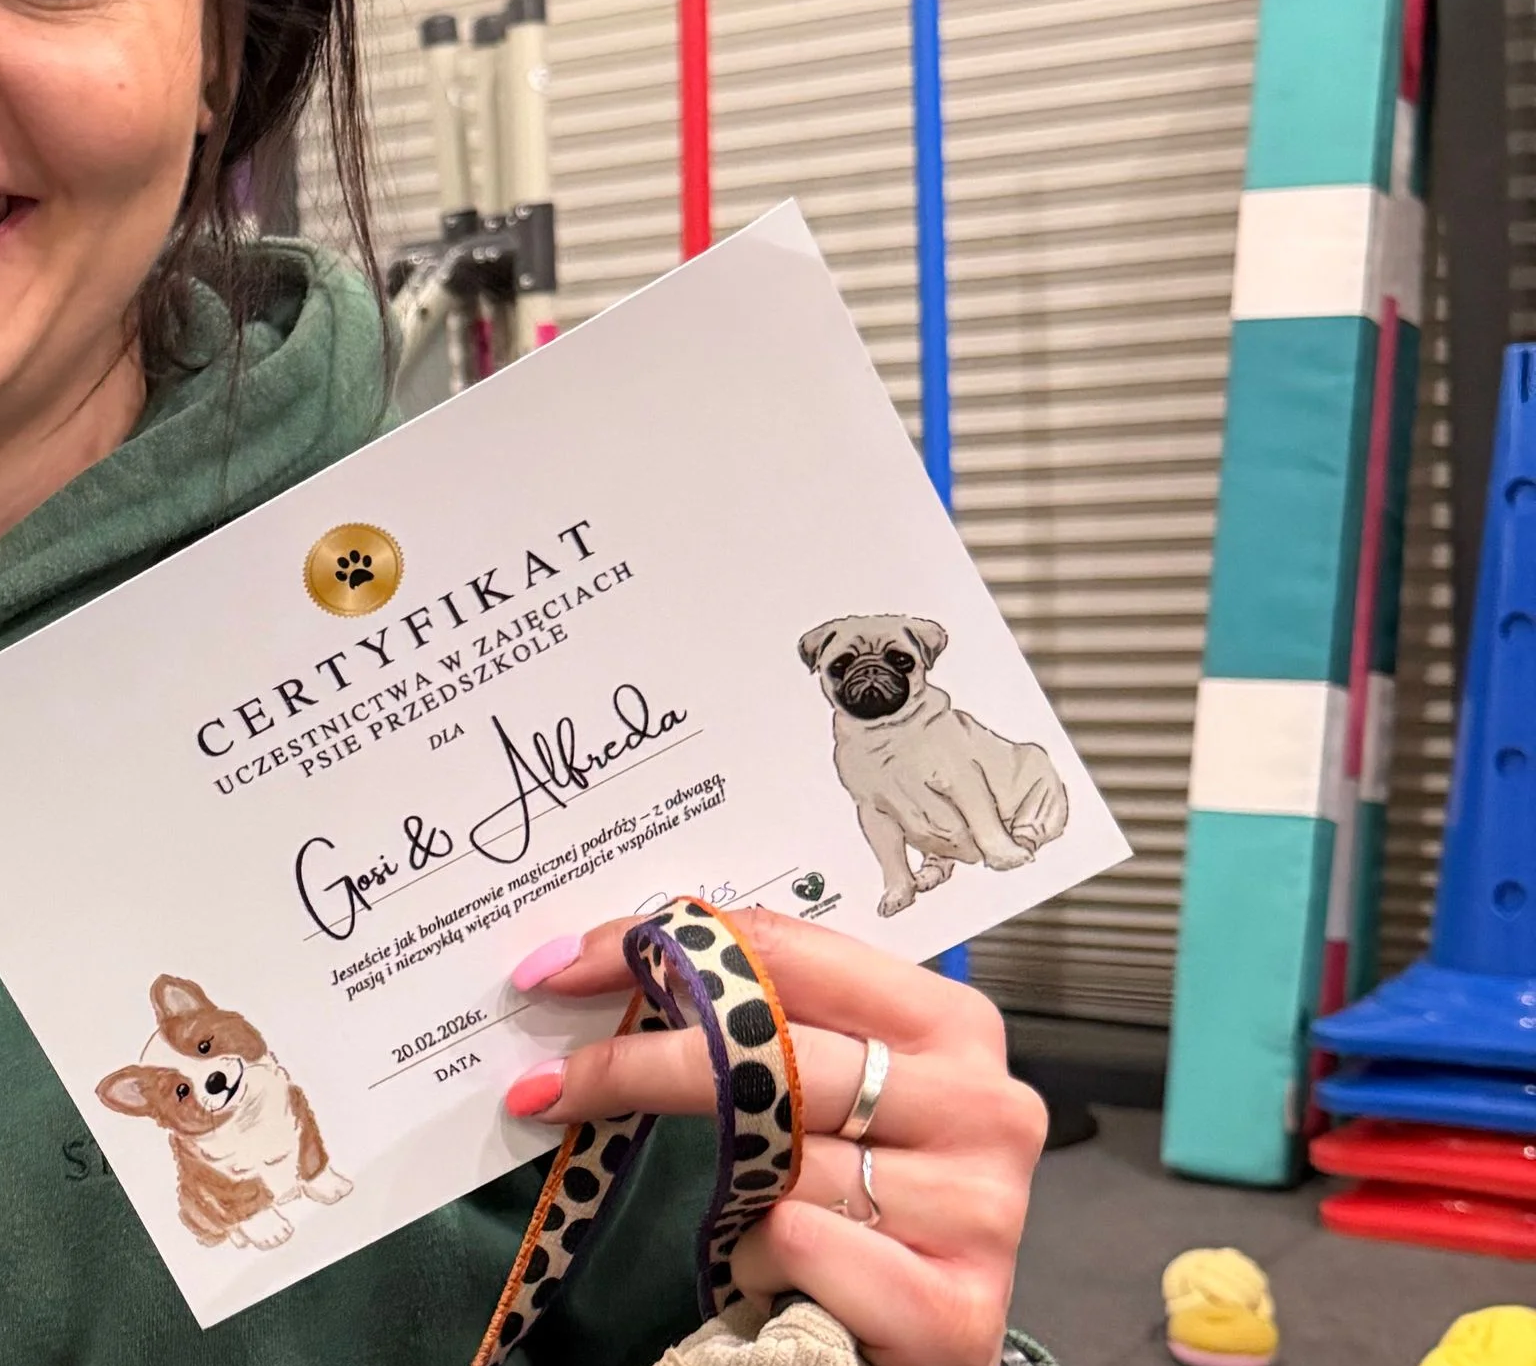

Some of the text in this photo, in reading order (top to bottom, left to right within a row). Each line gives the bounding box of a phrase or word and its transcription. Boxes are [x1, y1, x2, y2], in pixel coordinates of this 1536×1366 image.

[197, 519, 595, 757] CERTYFIKAT
[213, 560, 634, 795] UCZESTNICTWA W ZAJĘCIACH
[298, 623, 568, 778] PSIE PRZEDSZKOLE
[428, 722, 465, 751] DLA
[295, 683, 688, 941] Gosi & Alfreda
[331, 946, 391, 986] Jesteście
[394, 930, 417, 956] jak
[417, 886, 504, 940] bohaterowie
[507, 847, 578, 892] magicznej
[580, 816, 637, 858] podróży
[652, 804, 664, 817] z
[664, 773, 726, 811] odwagą,
[345, 970, 386, 1002] pasją
[385, 962, 393, 977] i
[395, 928, 465, 972] niezwykłą
[465, 903, 512, 934] więzią
[513, 849, 615, 914] przemierzajcie
[616, 815, 680, 854] wspólnie
[683, 786, 726, 822] świat!
[391, 1009, 488, 1064] 20.02.2026r.
[434, 1052, 482, 1083] DATA
